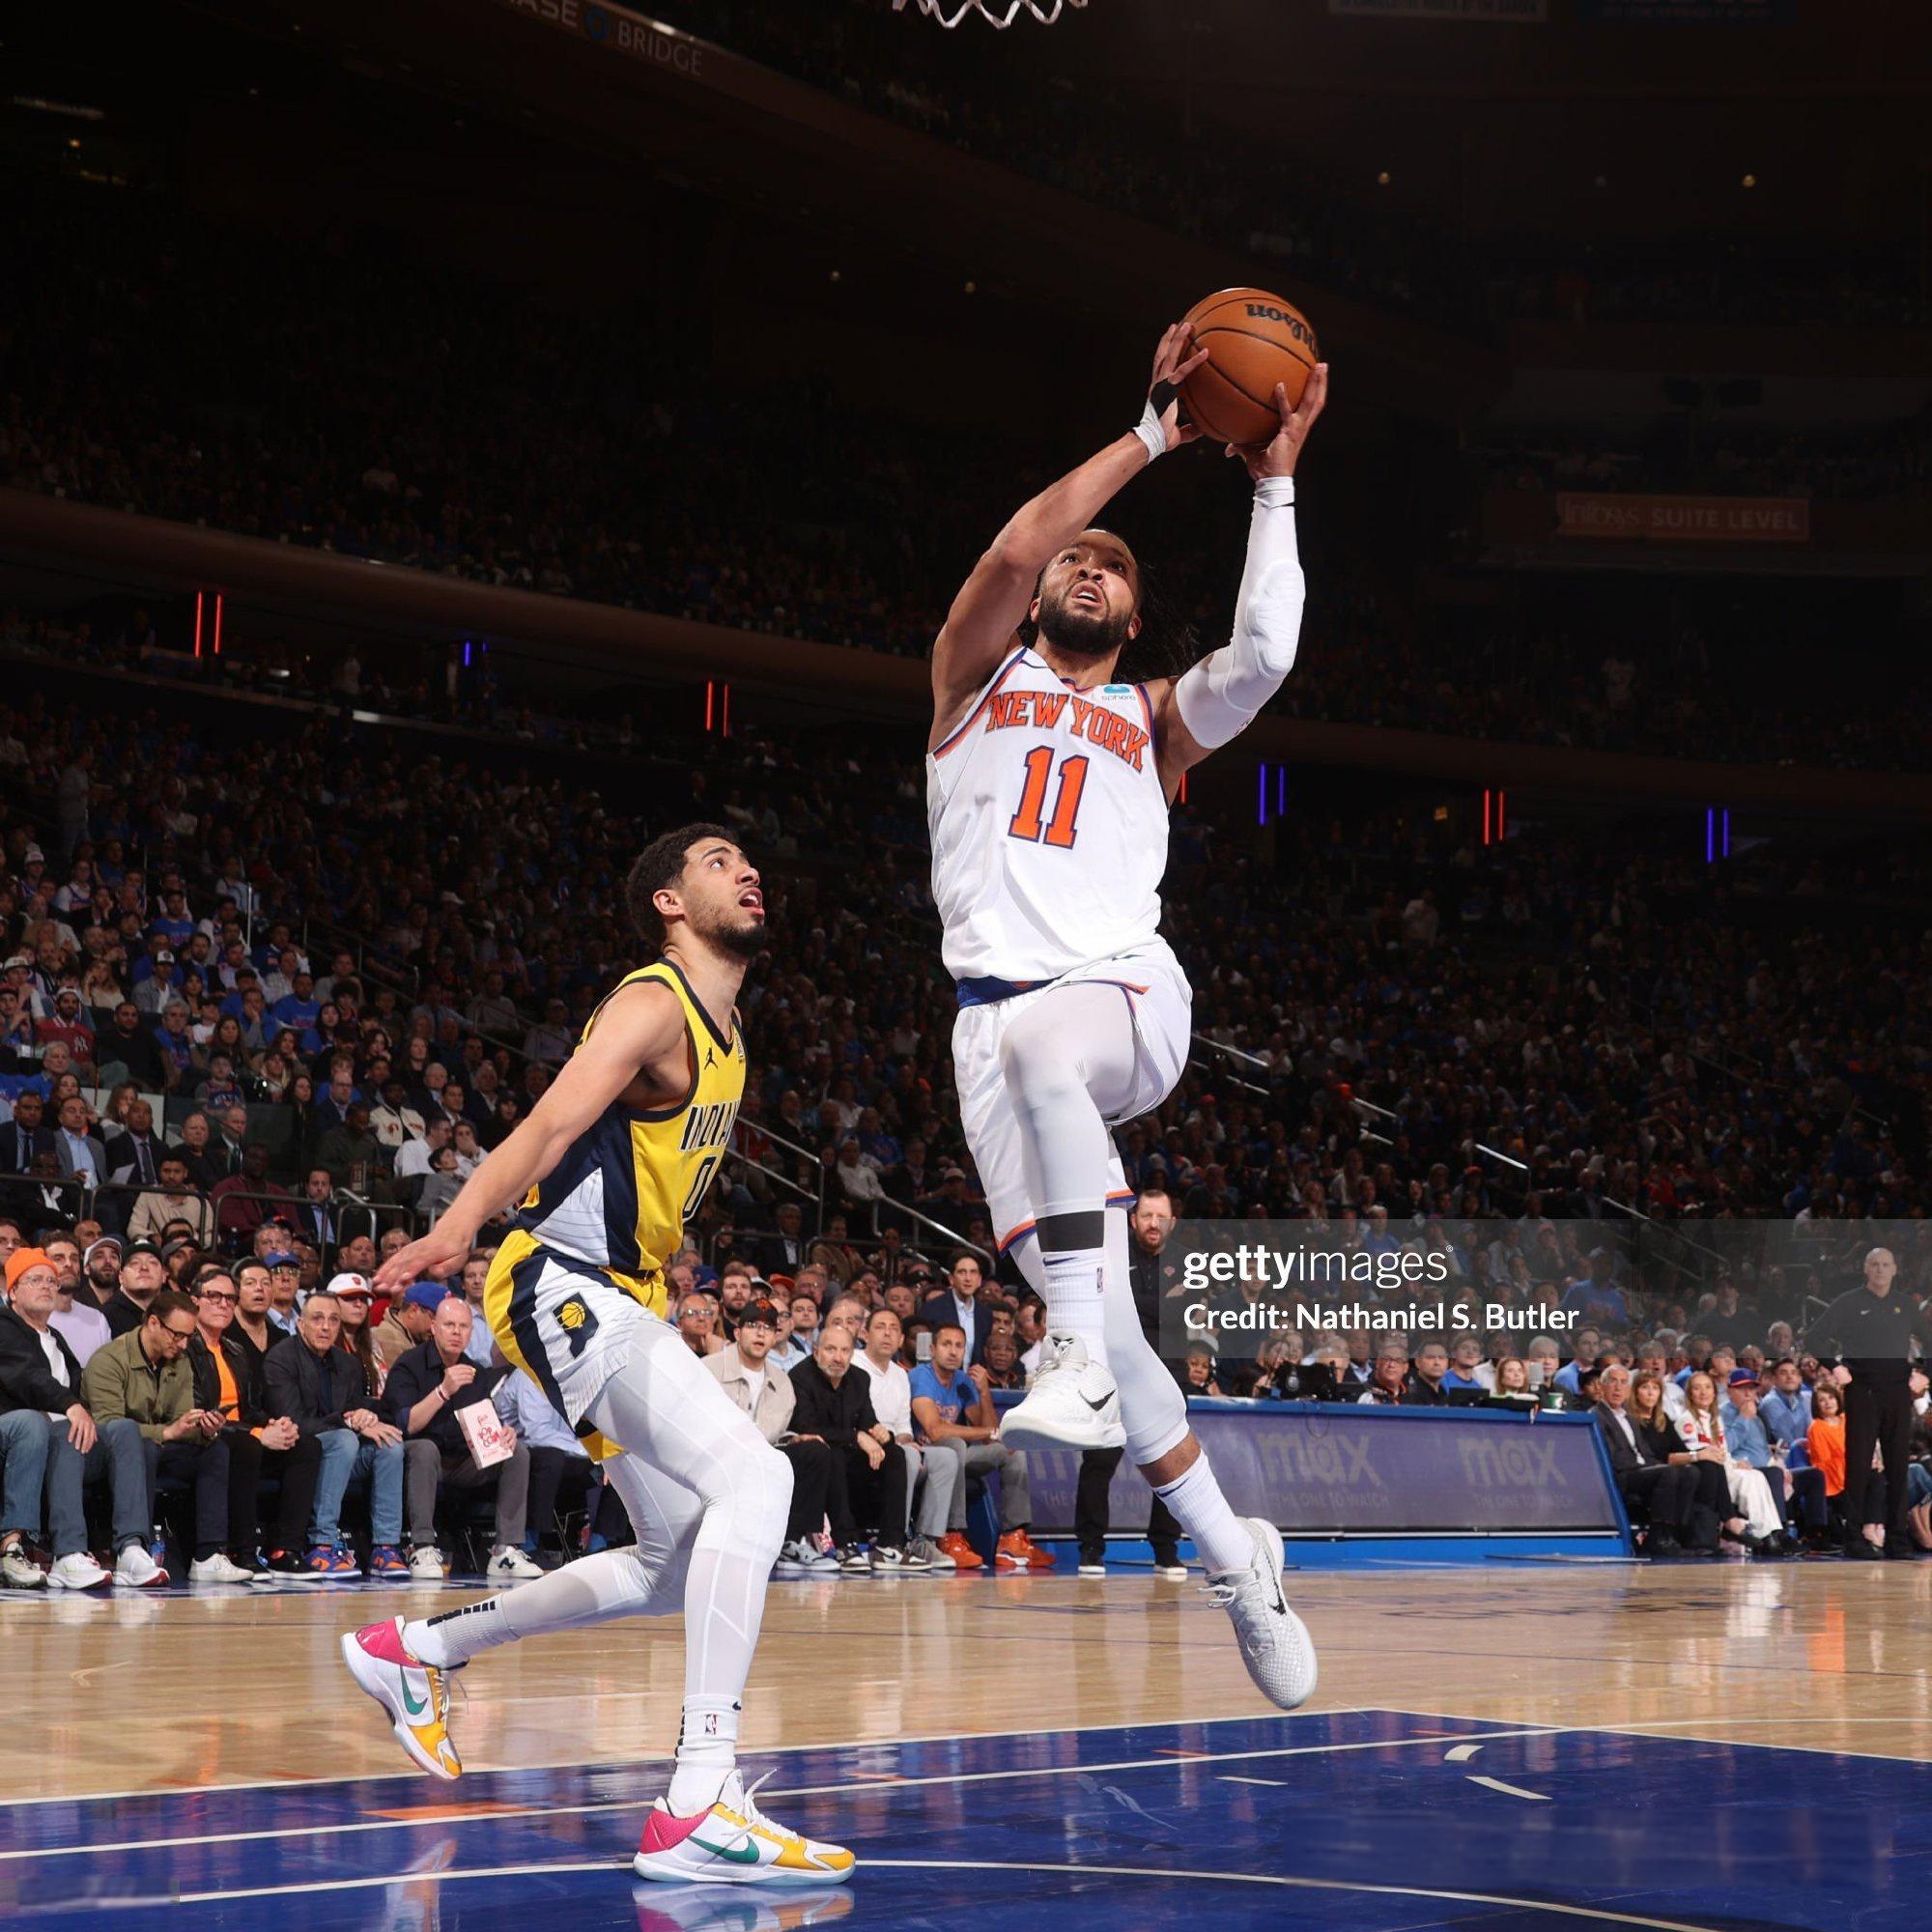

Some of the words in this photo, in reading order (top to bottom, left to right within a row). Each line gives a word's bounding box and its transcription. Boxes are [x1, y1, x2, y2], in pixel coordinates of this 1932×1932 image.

[618, 20, 703, 76] BRIDGE
[1651, 506, 1719, 527] SUITE
[1727, 509, 1801, 529] LEVEL
[984, 691, 1070, 734] NEW
[1070, 695, 1150, 774] YORK
[1008, 745, 1090, 850] 11
[682, 1155, 718, 1224] 0
[1257, 1434, 1381, 1486] max
[1457, 1438, 1569, 1486] max
